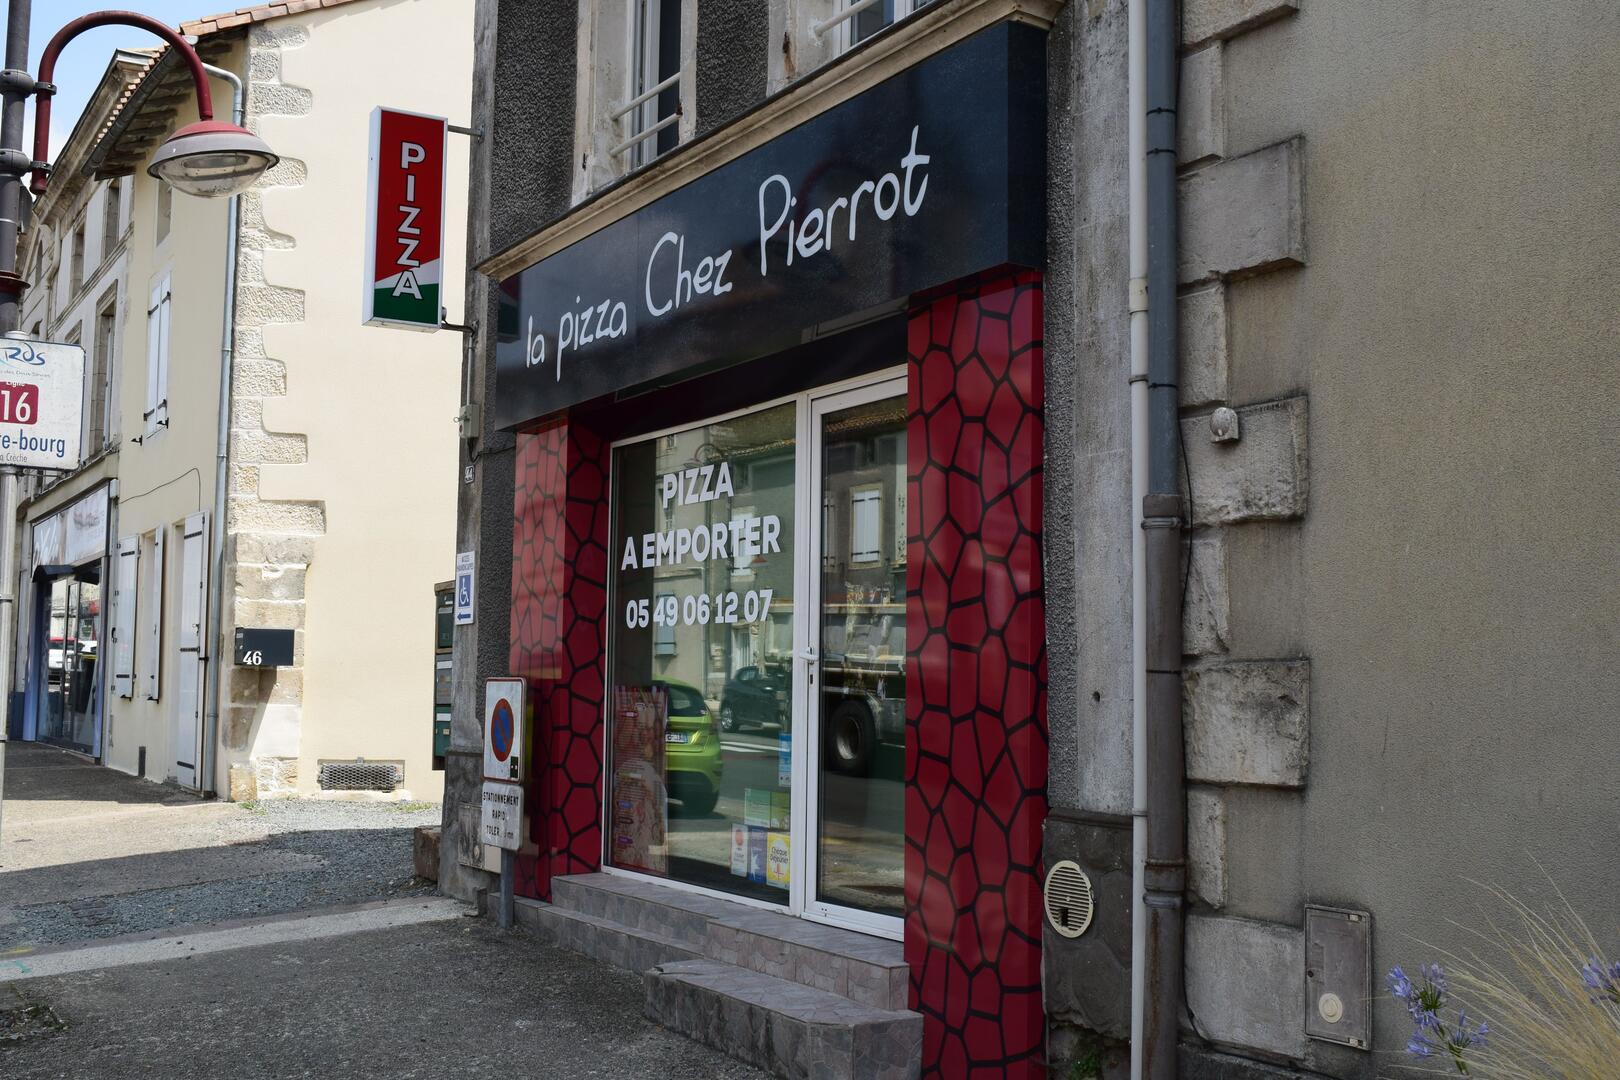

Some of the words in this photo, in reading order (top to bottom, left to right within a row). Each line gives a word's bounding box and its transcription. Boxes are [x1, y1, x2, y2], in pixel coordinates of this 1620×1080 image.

[392, 141, 426, 300] PIZZA
[526, 315, 546, 369] la
[556, 295, 628, 383] pizza
[645, 231, 733, 318] Chez
[758, 125, 931, 277] Pierrot
[662, 462, 735, 509] PIZZA
[621, 536, 638, 571] A
[642, 515, 781, 568] EMPORTER
[626, 599, 649, 630] 05
[653, 596, 679, 627] 49
[683, 593, 710, 626] 06
[714, 592, 738, 624] 12
[744, 589, 774, 622] 07
[242, 650, 262, 666] 46
[483, 791, 519, 807] STATIONNEMENT
